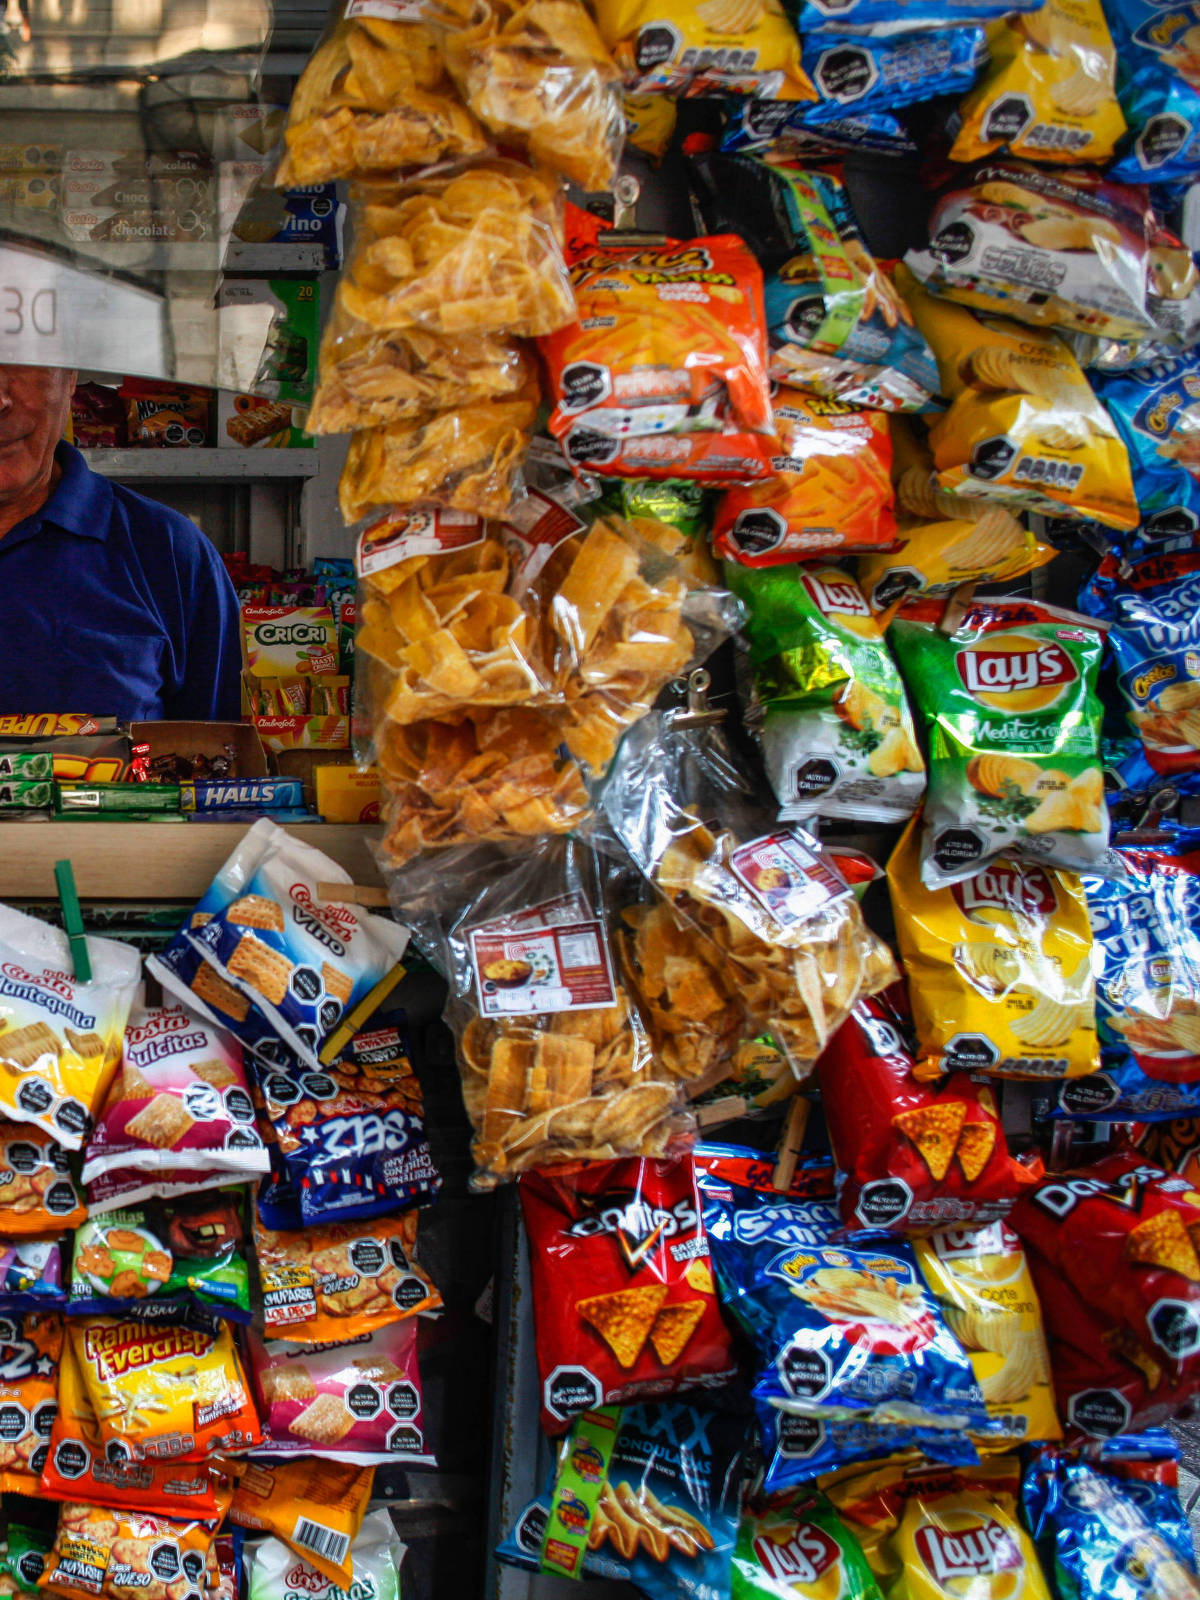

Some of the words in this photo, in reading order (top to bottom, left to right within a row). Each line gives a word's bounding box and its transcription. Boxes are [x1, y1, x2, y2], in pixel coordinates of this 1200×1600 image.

[71, 158, 104, 171] Costa
[114, 223, 176, 237] Chocolate
[299, 286, 313, 297] 20
[808, 575, 870, 617] Lay
[245, 607, 284, 616] Ambrosoli
[257, 624, 327, 646] CRICRI
[964, 644, 1065, 692] Lay's
[258, 718, 296, 729] Ambrosoli
[204, 785, 276, 806] HALLS
[959, 868, 1047, 909] Lay's
[289, 882, 353, 943] Costa
[292, 904, 346, 957] Vino
[1, 962, 74, 1000] Costa
[320, 1109, 409, 1158] SELZ
[323, 1274, 360, 1296] QUESO
[979, 1287, 1019, 1301] Corte
[99, 1332, 211, 1379] Evercrisp
[761, 1528, 828, 1585] Lay's
[927, 1529, 1022, 1580] Lay's
[113, 1572, 151, 1587] QUESO
